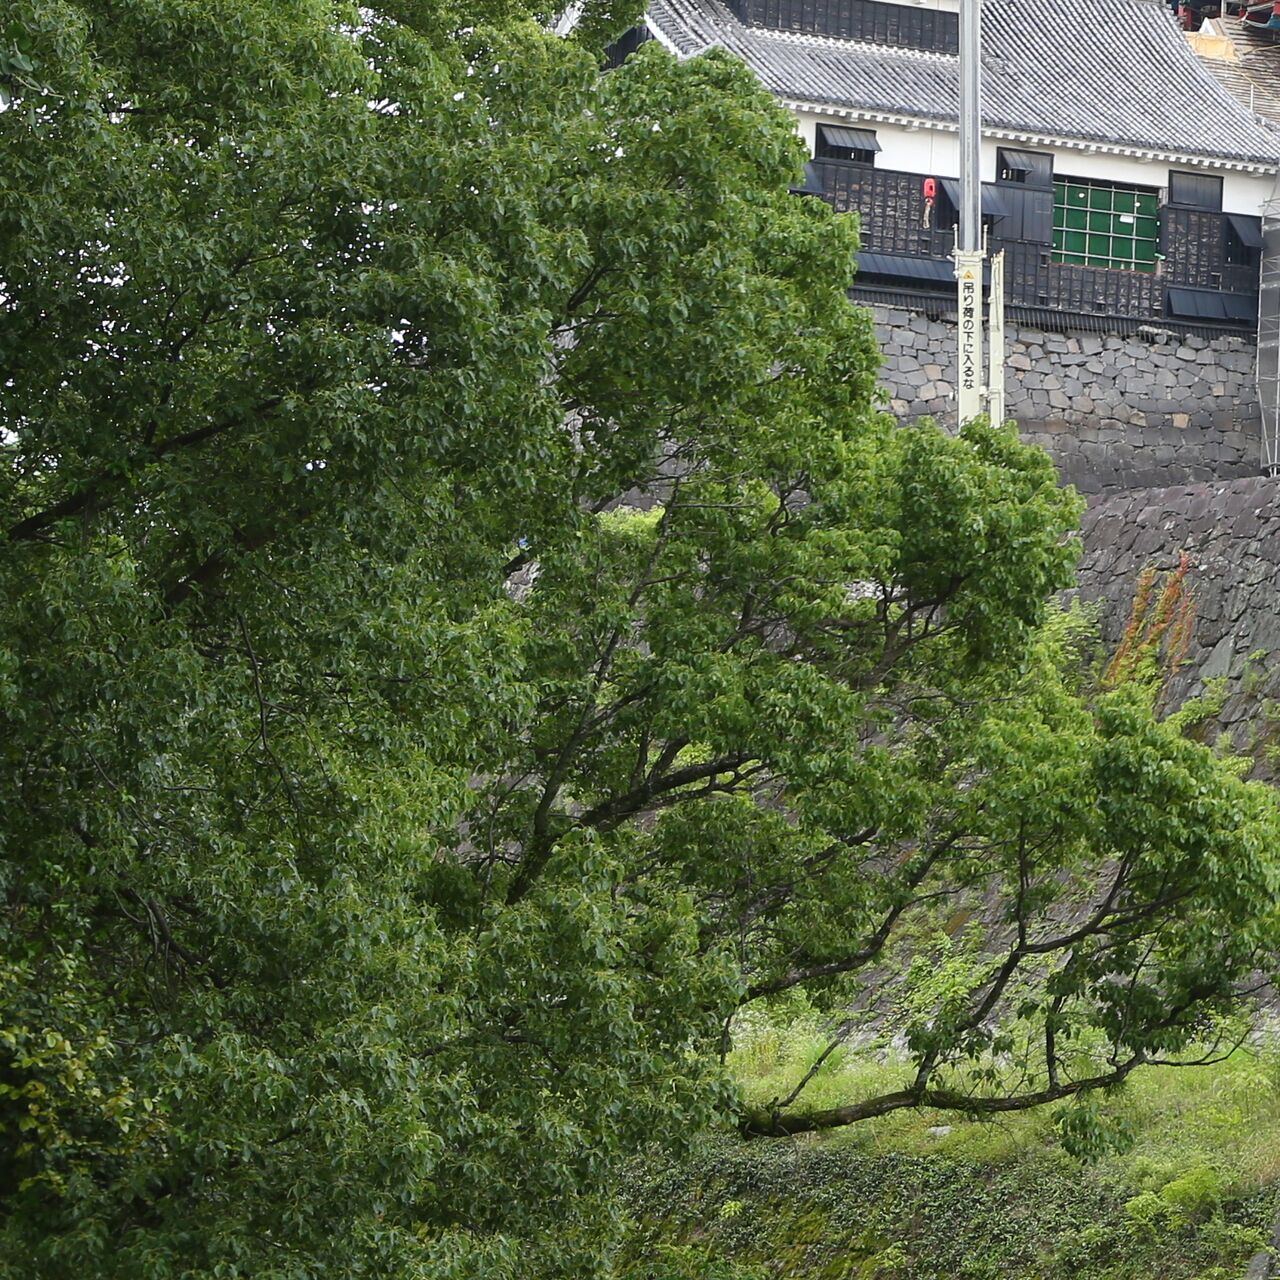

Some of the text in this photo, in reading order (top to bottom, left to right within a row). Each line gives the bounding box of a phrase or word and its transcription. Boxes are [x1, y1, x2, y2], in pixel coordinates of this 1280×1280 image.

[962, 281, 975, 390] 吊り荷の下に入るな
